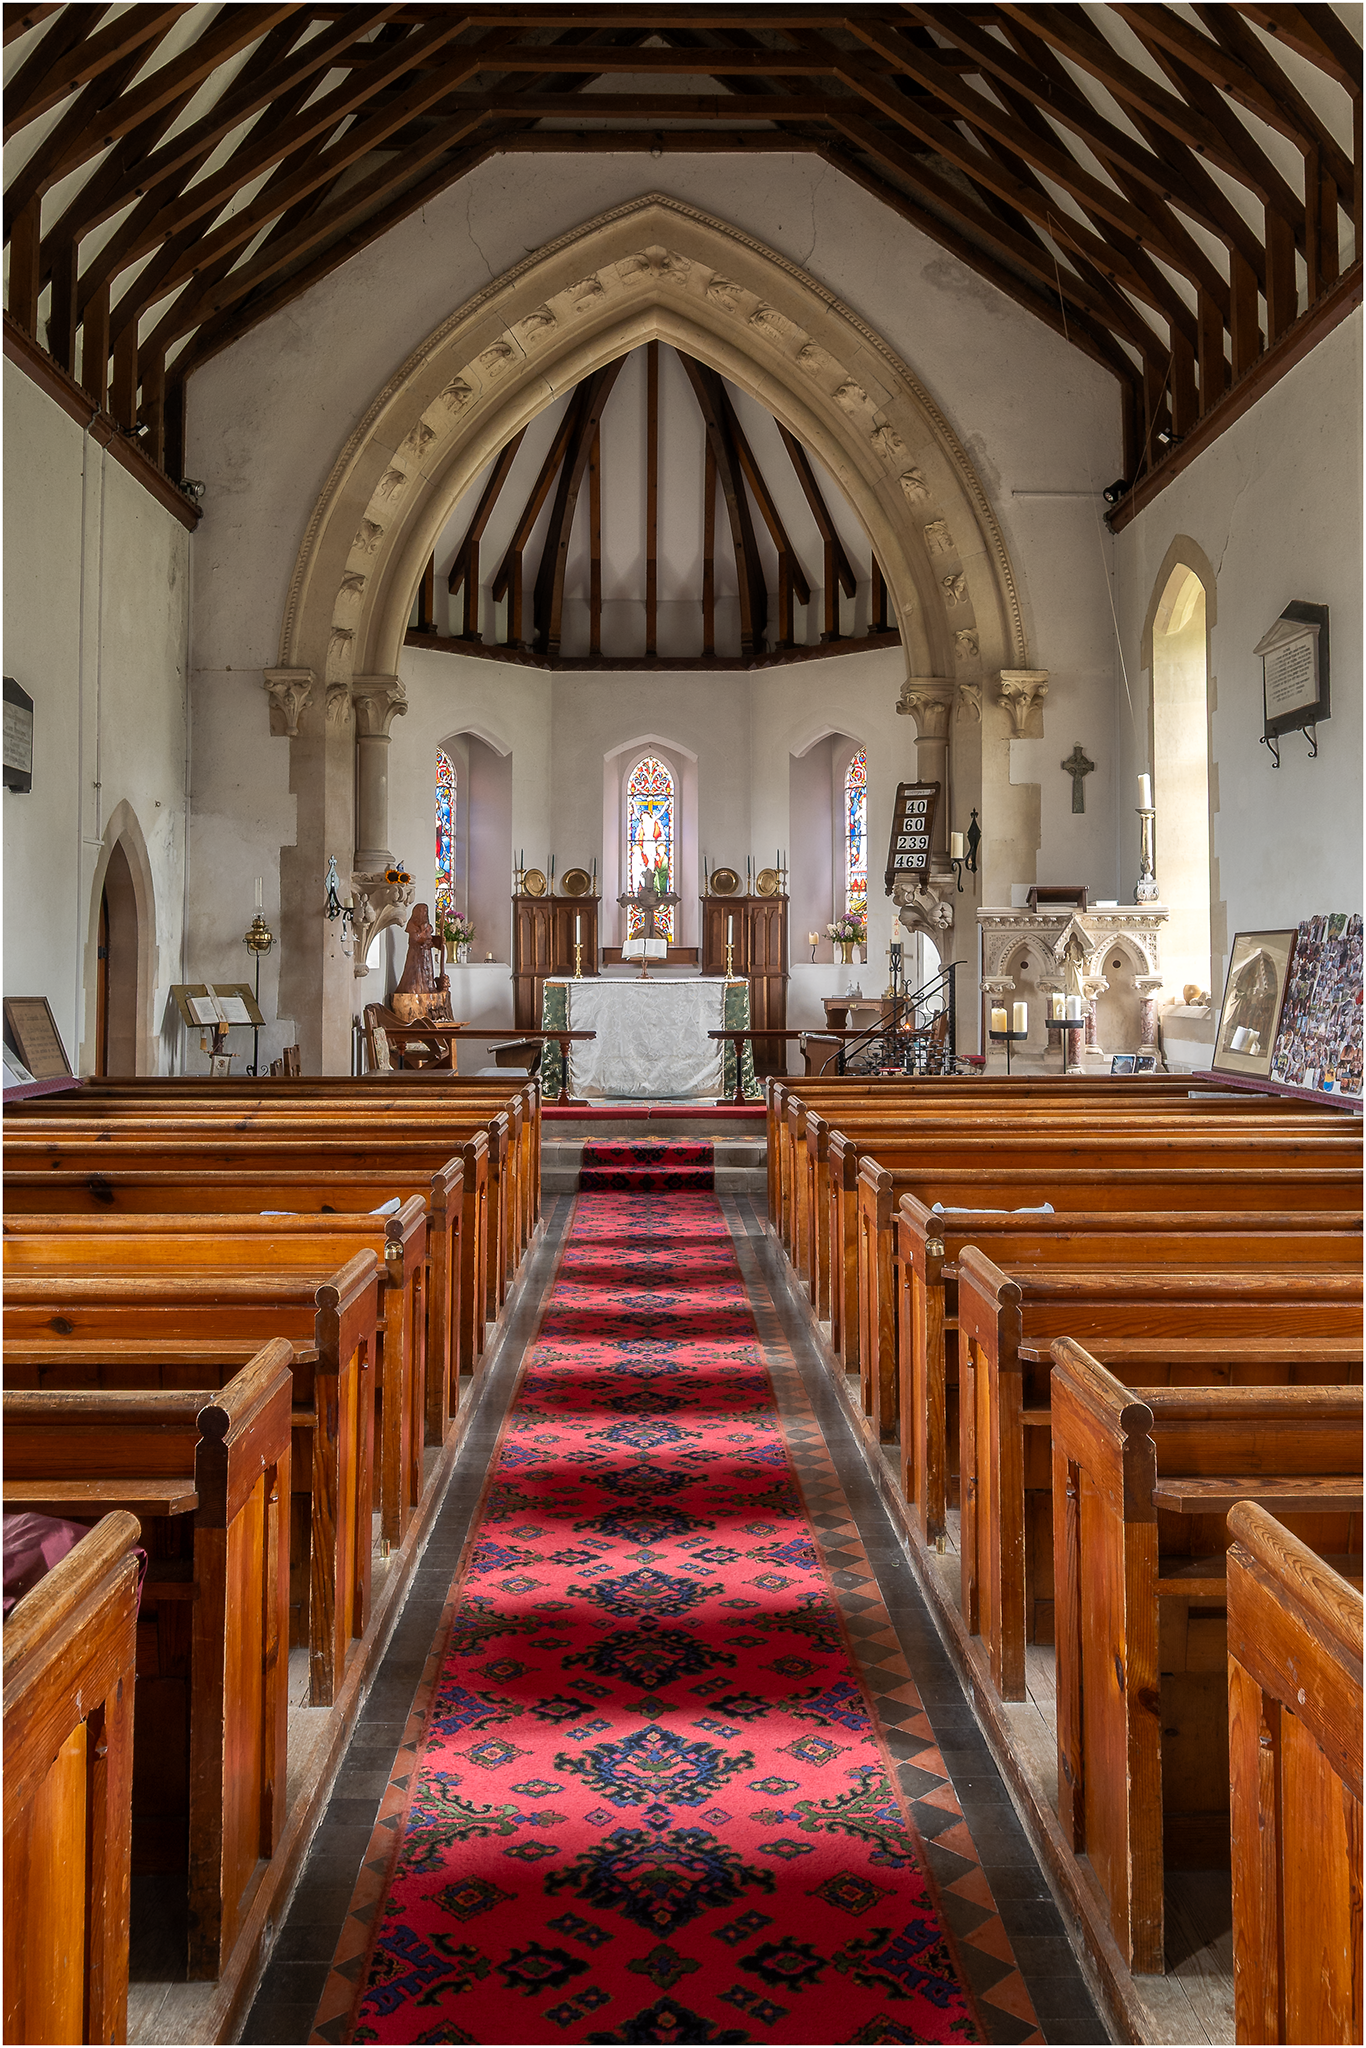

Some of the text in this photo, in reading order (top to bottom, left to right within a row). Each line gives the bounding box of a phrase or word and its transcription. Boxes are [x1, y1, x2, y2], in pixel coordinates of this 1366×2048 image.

[907, 801, 926, 813] 40
[905, 819, 924, 831] 60
[898, 837, 927, 849] 239
[896, 855, 924, 868] 469
